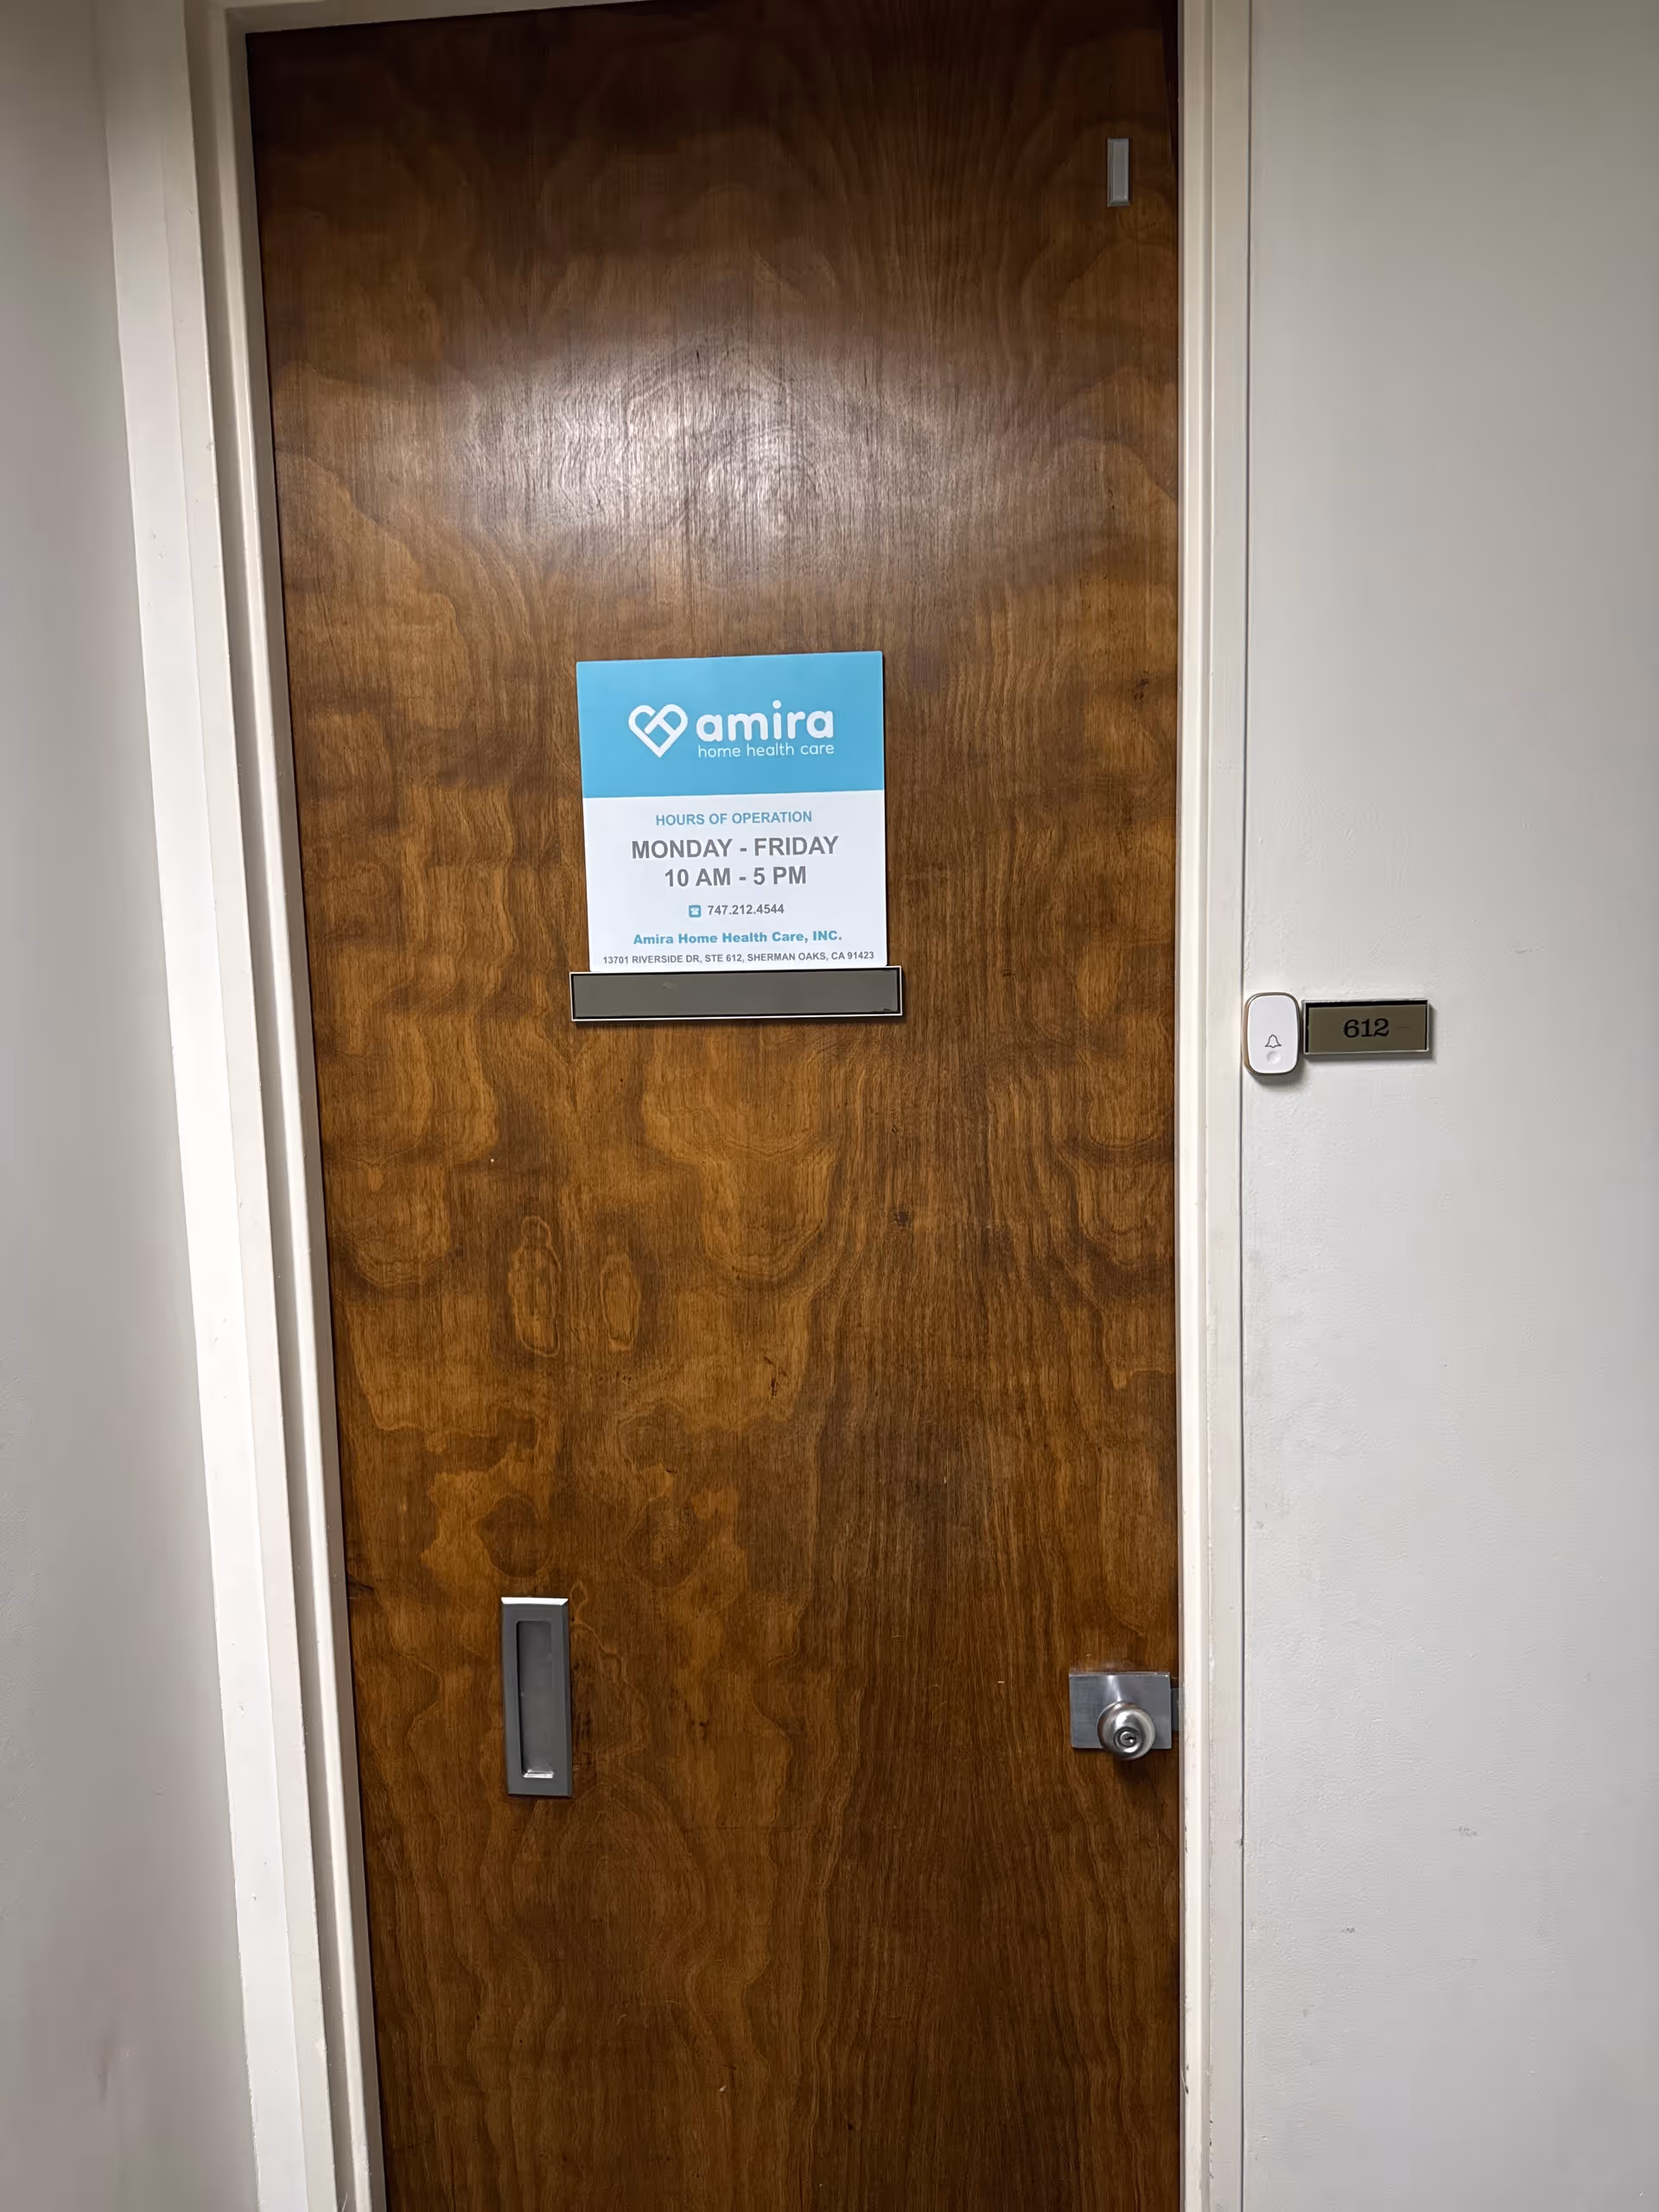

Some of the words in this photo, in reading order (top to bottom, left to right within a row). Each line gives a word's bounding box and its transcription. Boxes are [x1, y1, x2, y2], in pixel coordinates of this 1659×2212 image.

[696, 700, 834, 742] amira
[698, 744, 741, 758] home
[747, 742, 794, 756] health
[800, 743, 834, 754] care
[656, 814, 704, 826] HOURS
[709, 813, 728, 823] OF
[732, 810, 812, 823] OPERATION
[632, 838, 733, 859] MONDAY
[753, 836, 839, 856] FRIDAY
[664, 868, 690, 887] 10
[696, 868, 731, 886] AM
[753, 868, 766, 885] 5
[773, 866, 807, 884] PM
[708, 903, 785, 915] 747.212.4544
[633, 934, 674, 944] Amira
[678, 933, 717, 944] Home
[722, 932, 767, 943] Health
[772, 931, 808, 943] Care,
[812, 931, 842, 941] INC.
[603, 956, 629, 964] 13701
[632, 954, 683, 963] RIVERSIDE
[685, 955, 702, 963] DR,
[705, 954, 723, 963] STE
[726, 954, 745, 963] 612,
[747, 952, 796, 962] SHERMAN
[798, 952, 829, 962] OAKS,
[847, 951, 874, 960] 91423
[1344, 1018, 1389, 1039] 612
